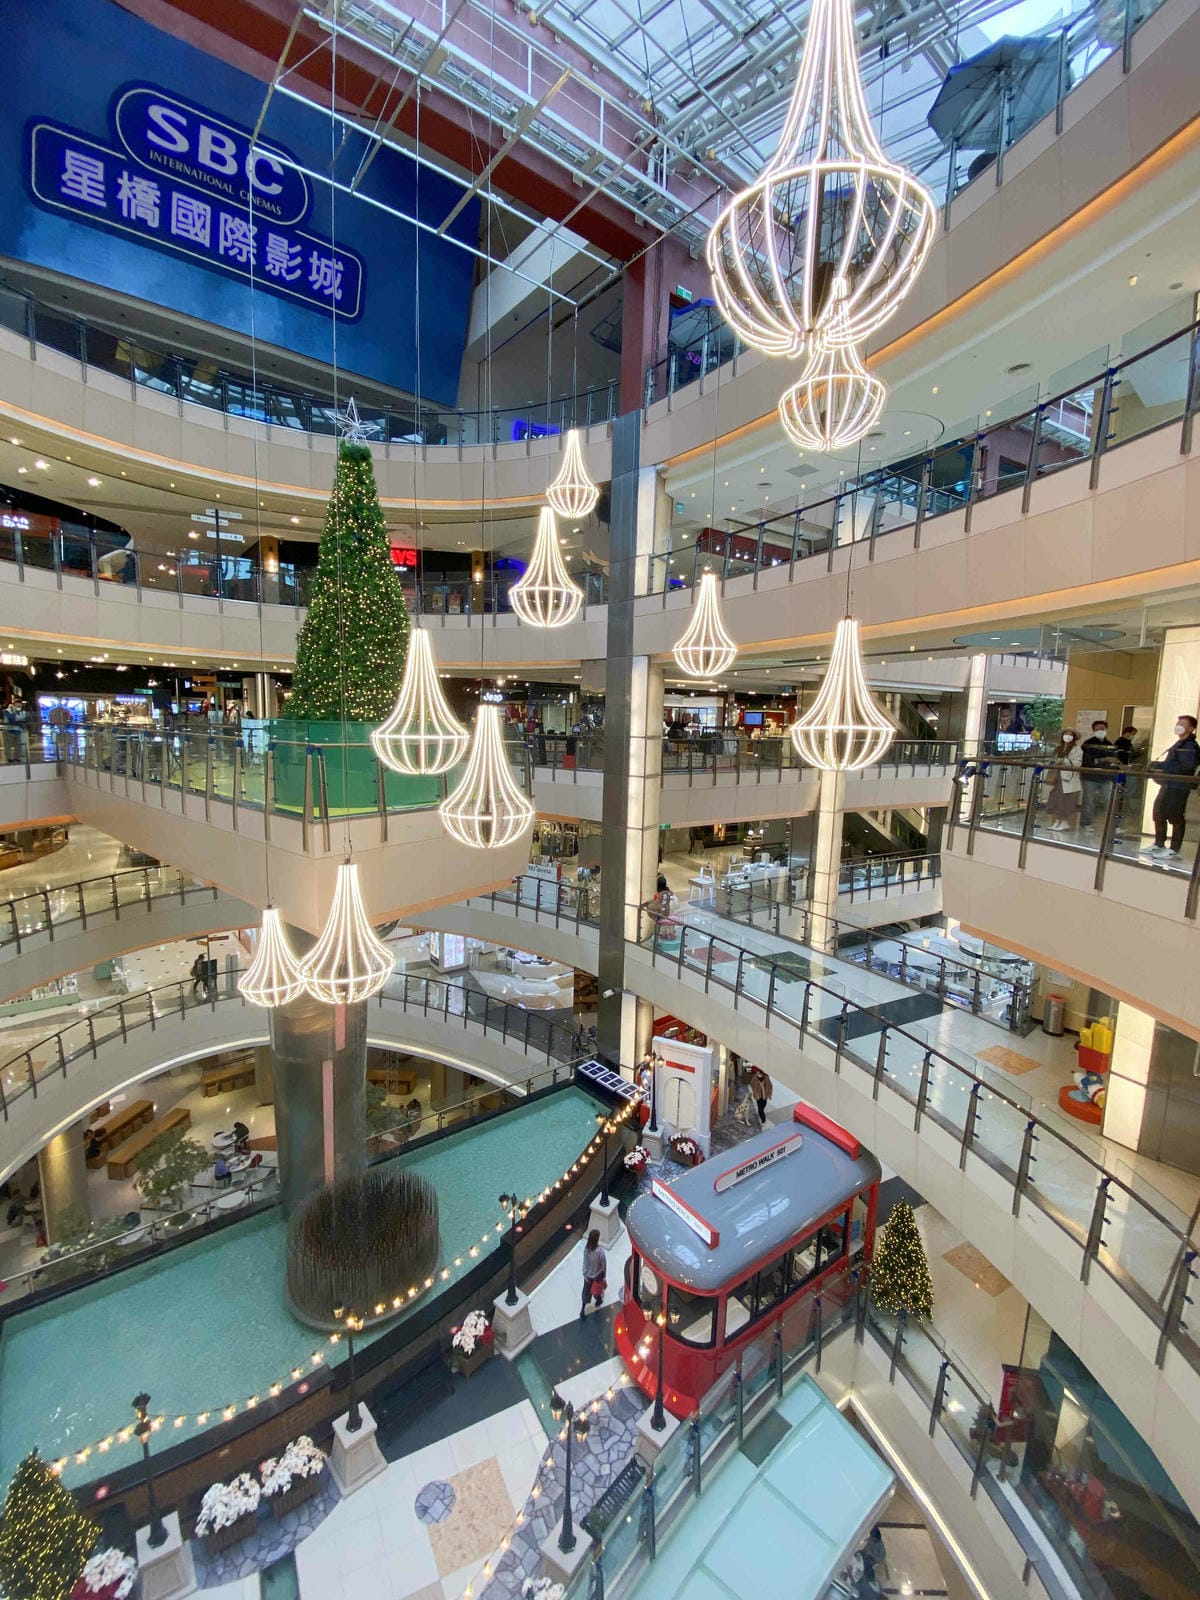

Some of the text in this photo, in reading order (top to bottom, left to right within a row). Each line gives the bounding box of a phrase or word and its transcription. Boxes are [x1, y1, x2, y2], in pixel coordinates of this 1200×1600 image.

[146, 104, 284, 195] SBC
[150, 150, 282, 216] INTERNATIONAL CINEMAS
[61, 149, 344, 301] 星橋國際影城
[736, 1146, 786, 1178] METRO WALK 501
